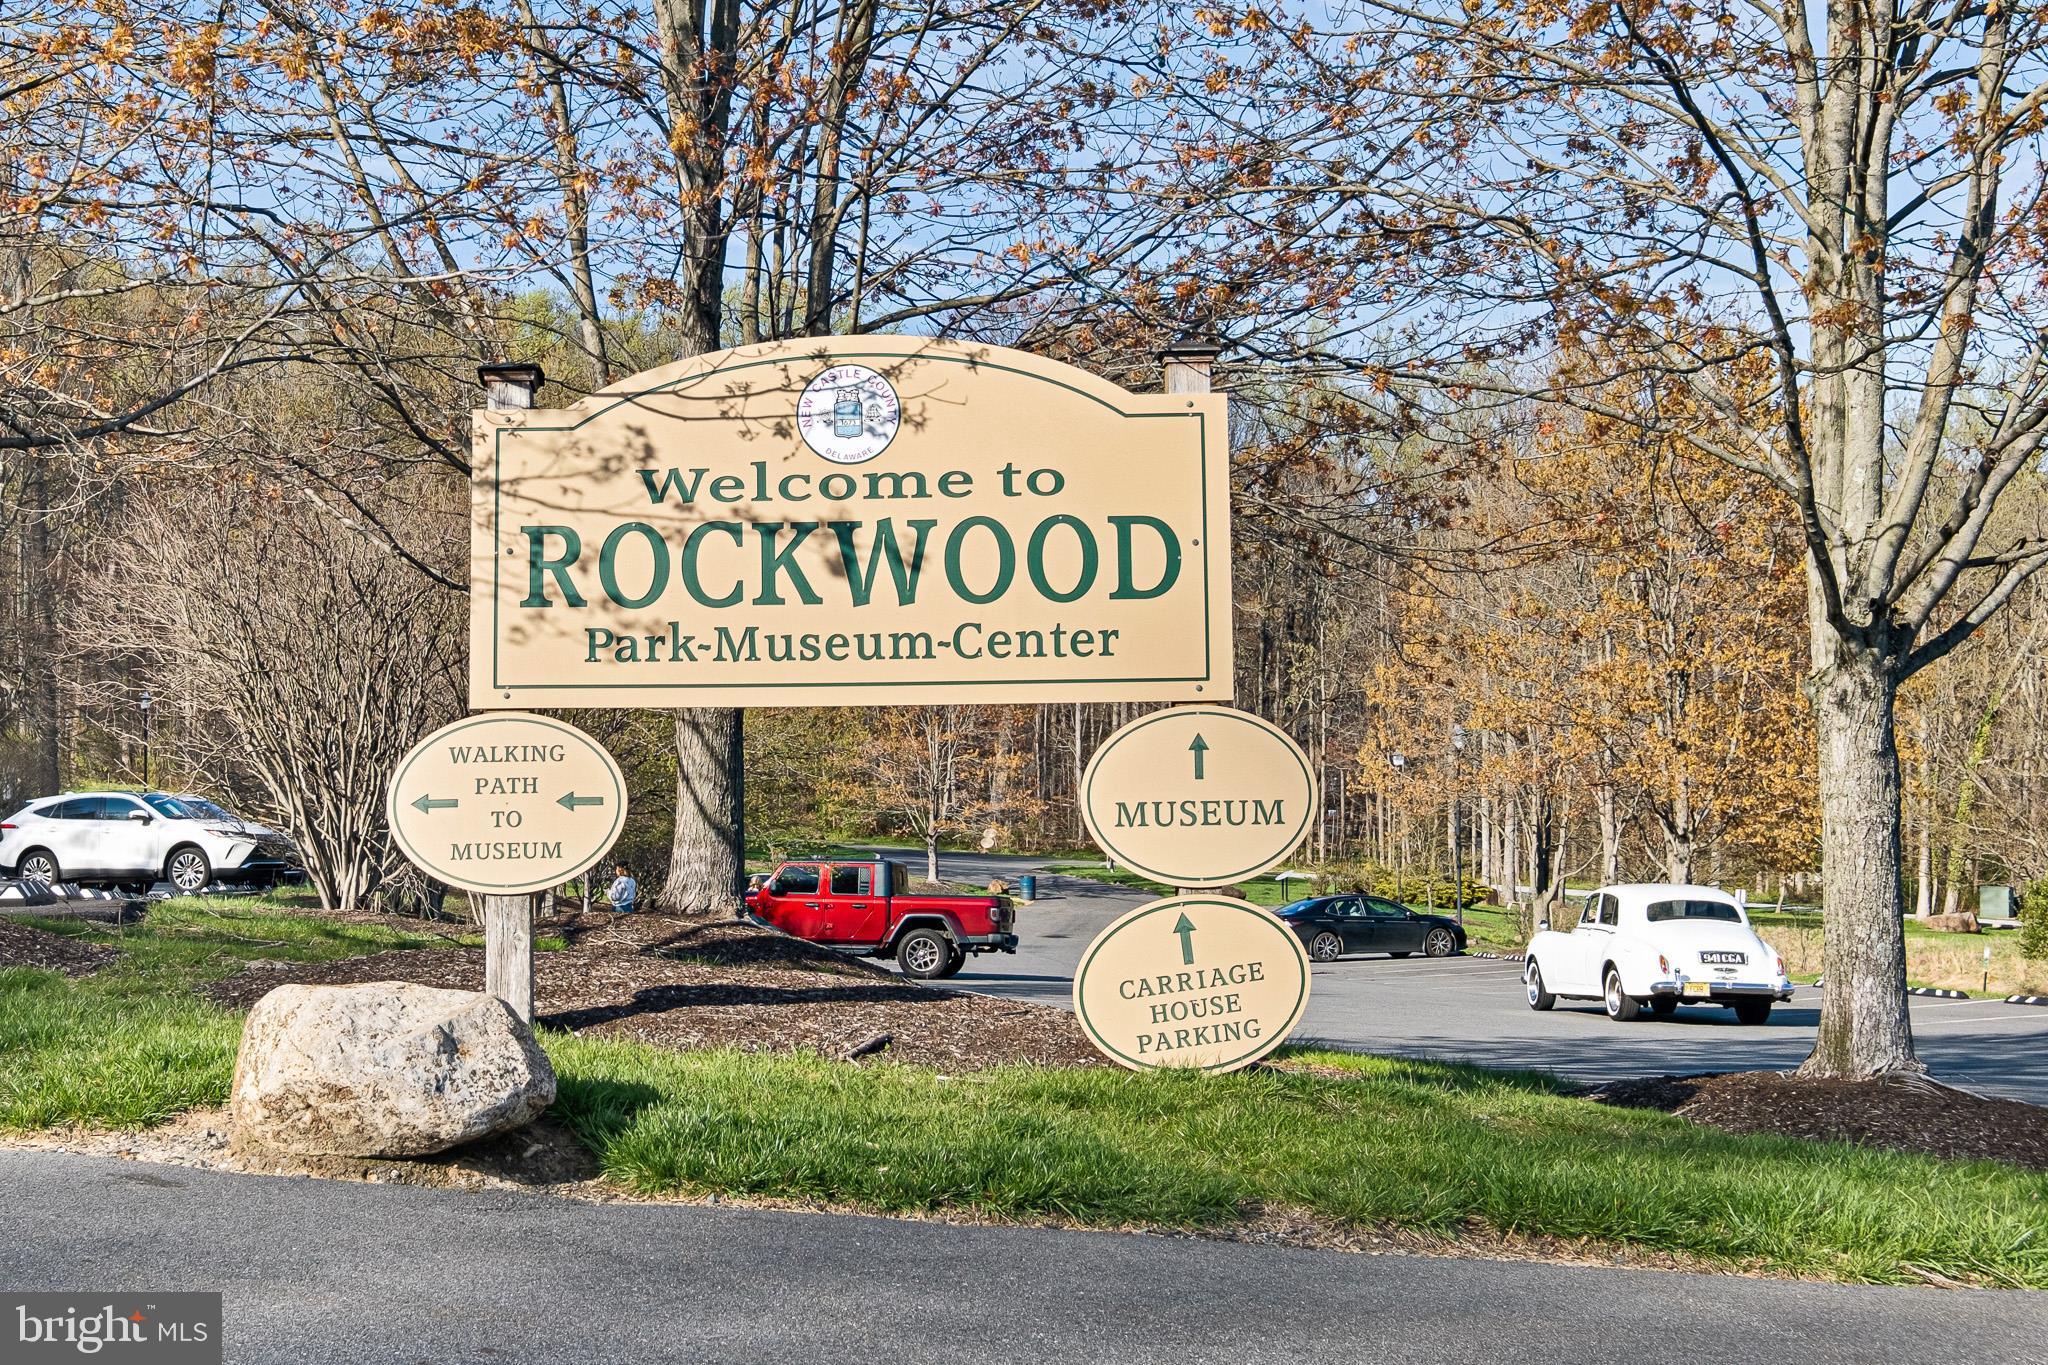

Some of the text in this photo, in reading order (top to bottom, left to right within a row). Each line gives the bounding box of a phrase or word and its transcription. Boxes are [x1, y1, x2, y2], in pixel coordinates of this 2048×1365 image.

[801, 369, 897, 427] NEW CASTLE COUNTY
[825, 446, 874, 461] DELAWARE
[637, 461, 1066, 504] Welcome to
[519, 514, 1183, 609] ROCKWOOD
[584, 621, 1119, 664] Park-Museum-Center
[449, 744, 566, 764] WALKING
[474, 777, 538, 795] PATH
[490, 810, 522, 828] TO
[1114, 799, 1286, 828] MUSEUM
[450, 841, 562, 860] MUSEUM
[1119, 961, 1265, 1000] CARRIAGE
[1149, 993, 1242, 1024] HOUSE
[1136, 1018, 1262, 1054] PARKING
